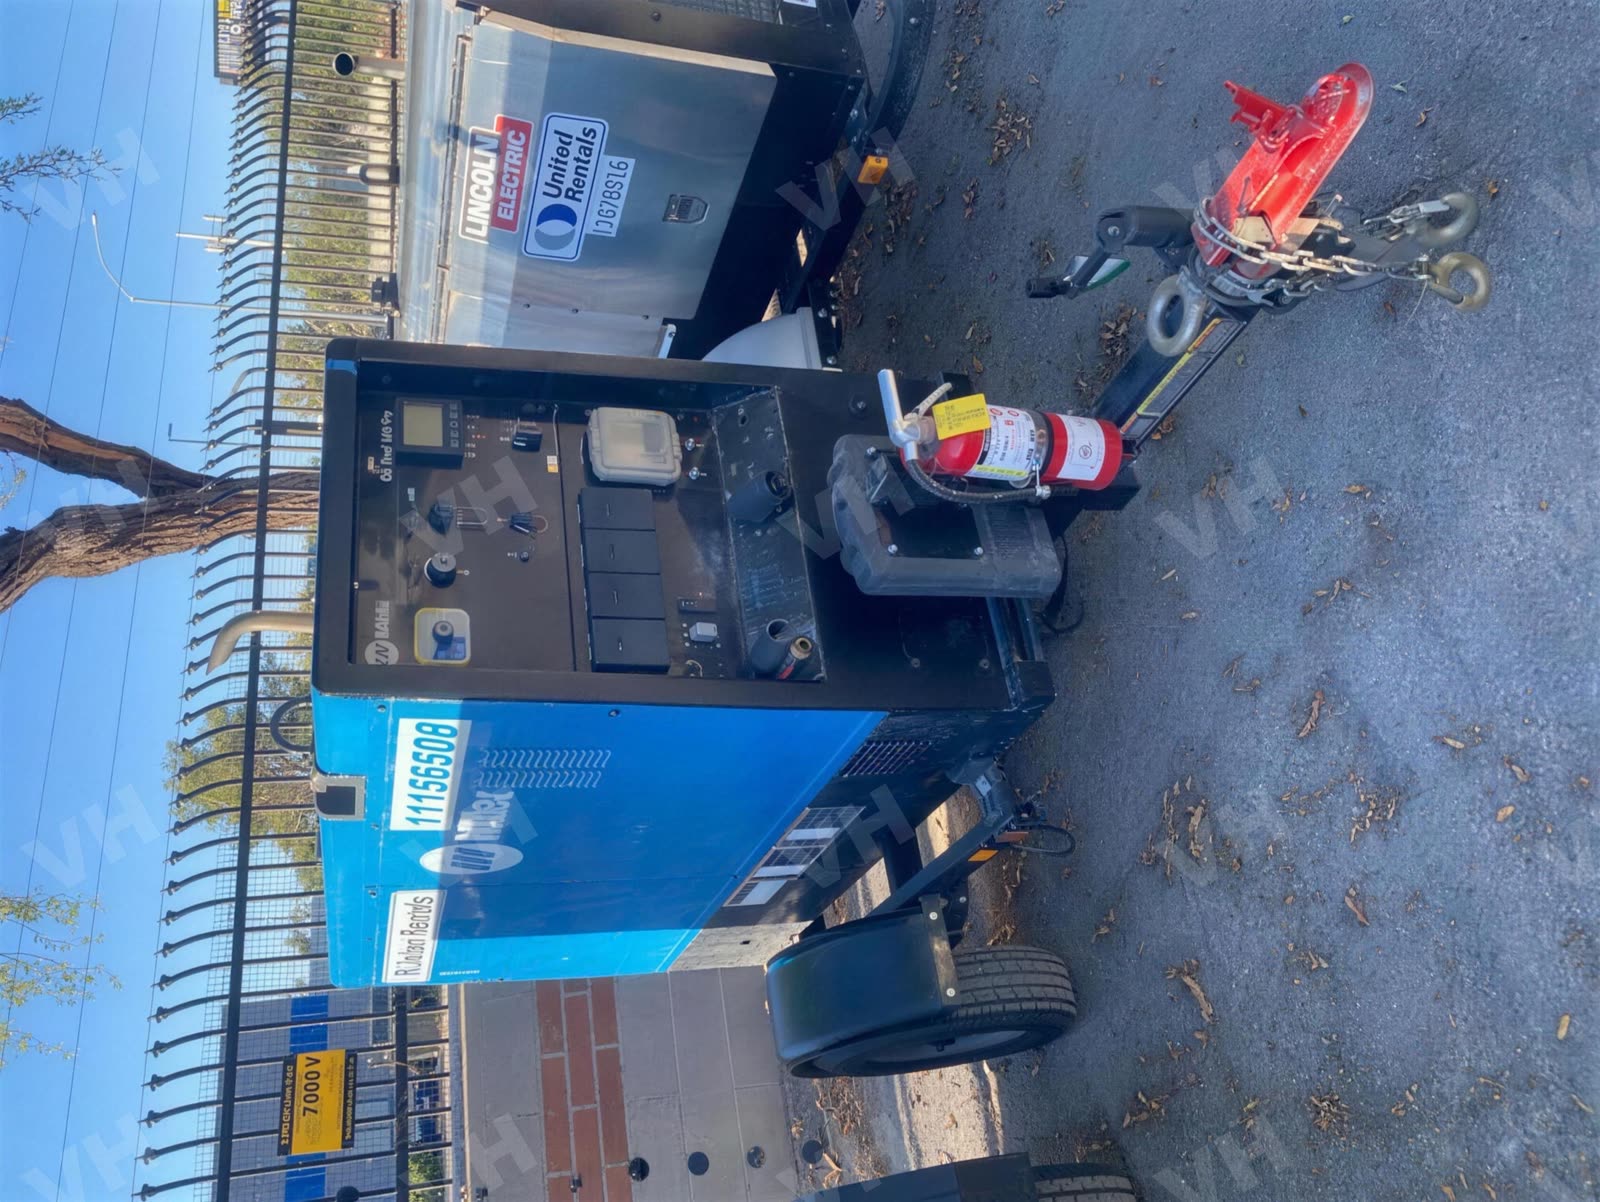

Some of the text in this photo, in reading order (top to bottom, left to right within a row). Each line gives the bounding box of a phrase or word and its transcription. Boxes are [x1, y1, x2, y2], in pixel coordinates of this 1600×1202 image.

[465, 135, 498, 237] LINCOLN
[497, 130, 526, 220] ELECTRIC
[542, 130, 573, 198] United
[564, 127, 597, 202] Rentals
[405, 722, 458, 826] 11156508
[302, 1070, 320, 1116] 7000
[304, 1056, 320, 1067] V
